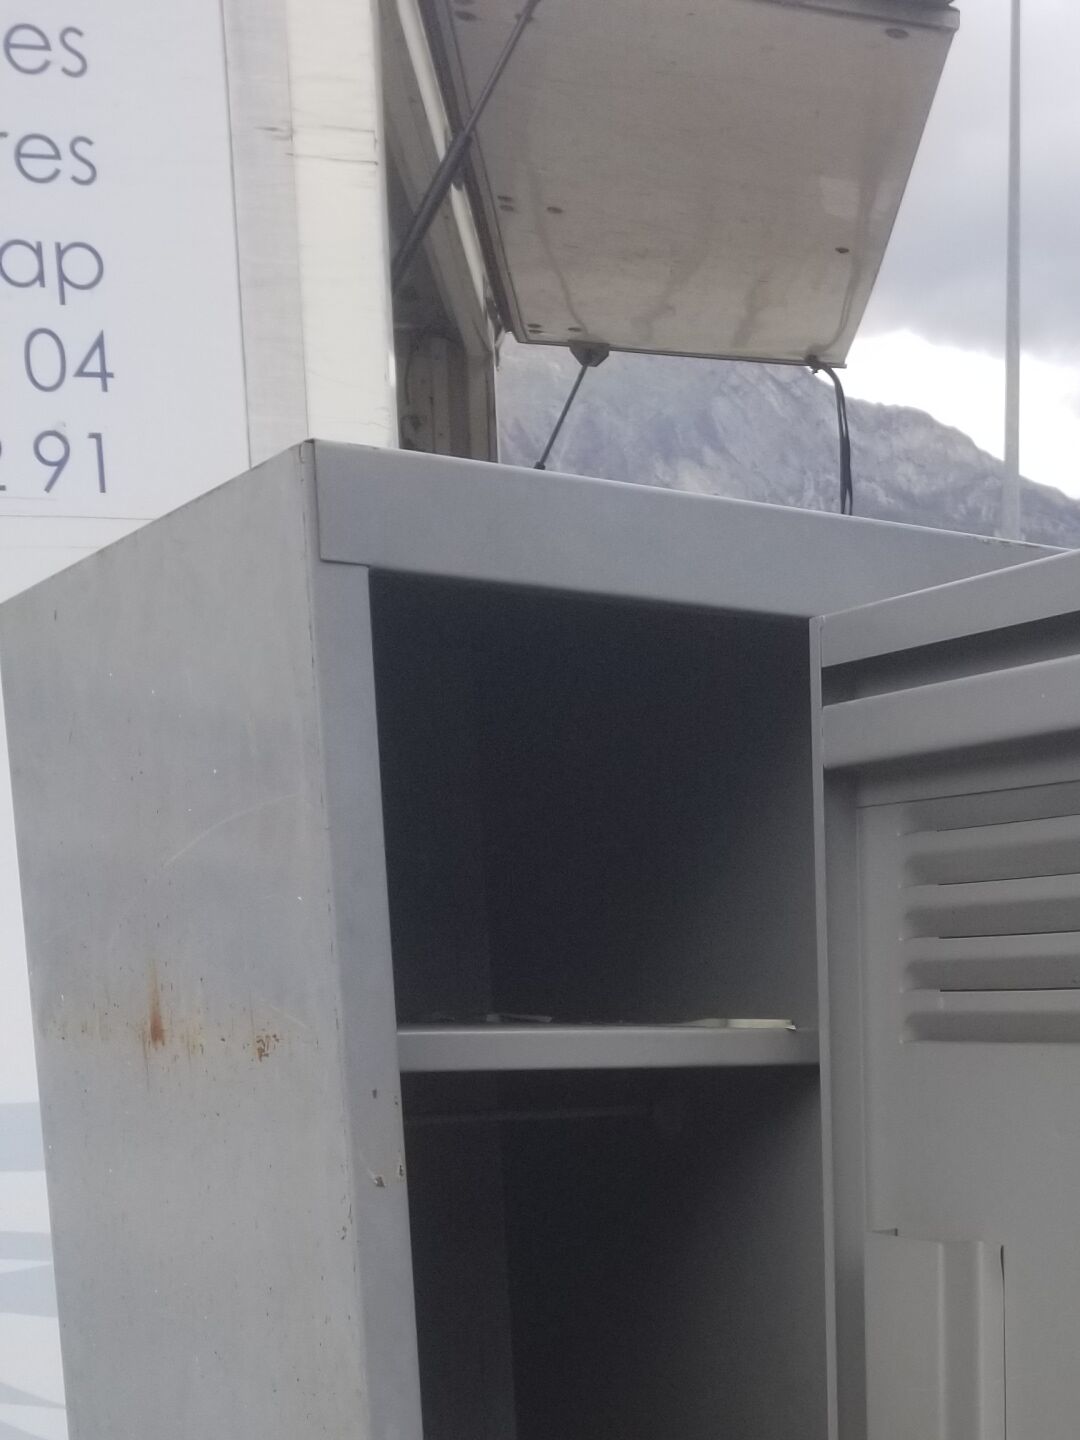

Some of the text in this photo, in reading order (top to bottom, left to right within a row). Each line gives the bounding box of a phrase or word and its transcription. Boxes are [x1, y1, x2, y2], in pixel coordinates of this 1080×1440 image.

[0, 132, 98, 186] es
[0, 238, 104, 305] ap
[24, 327, 115, 393] 04
[33, 429, 107, 494] 91
